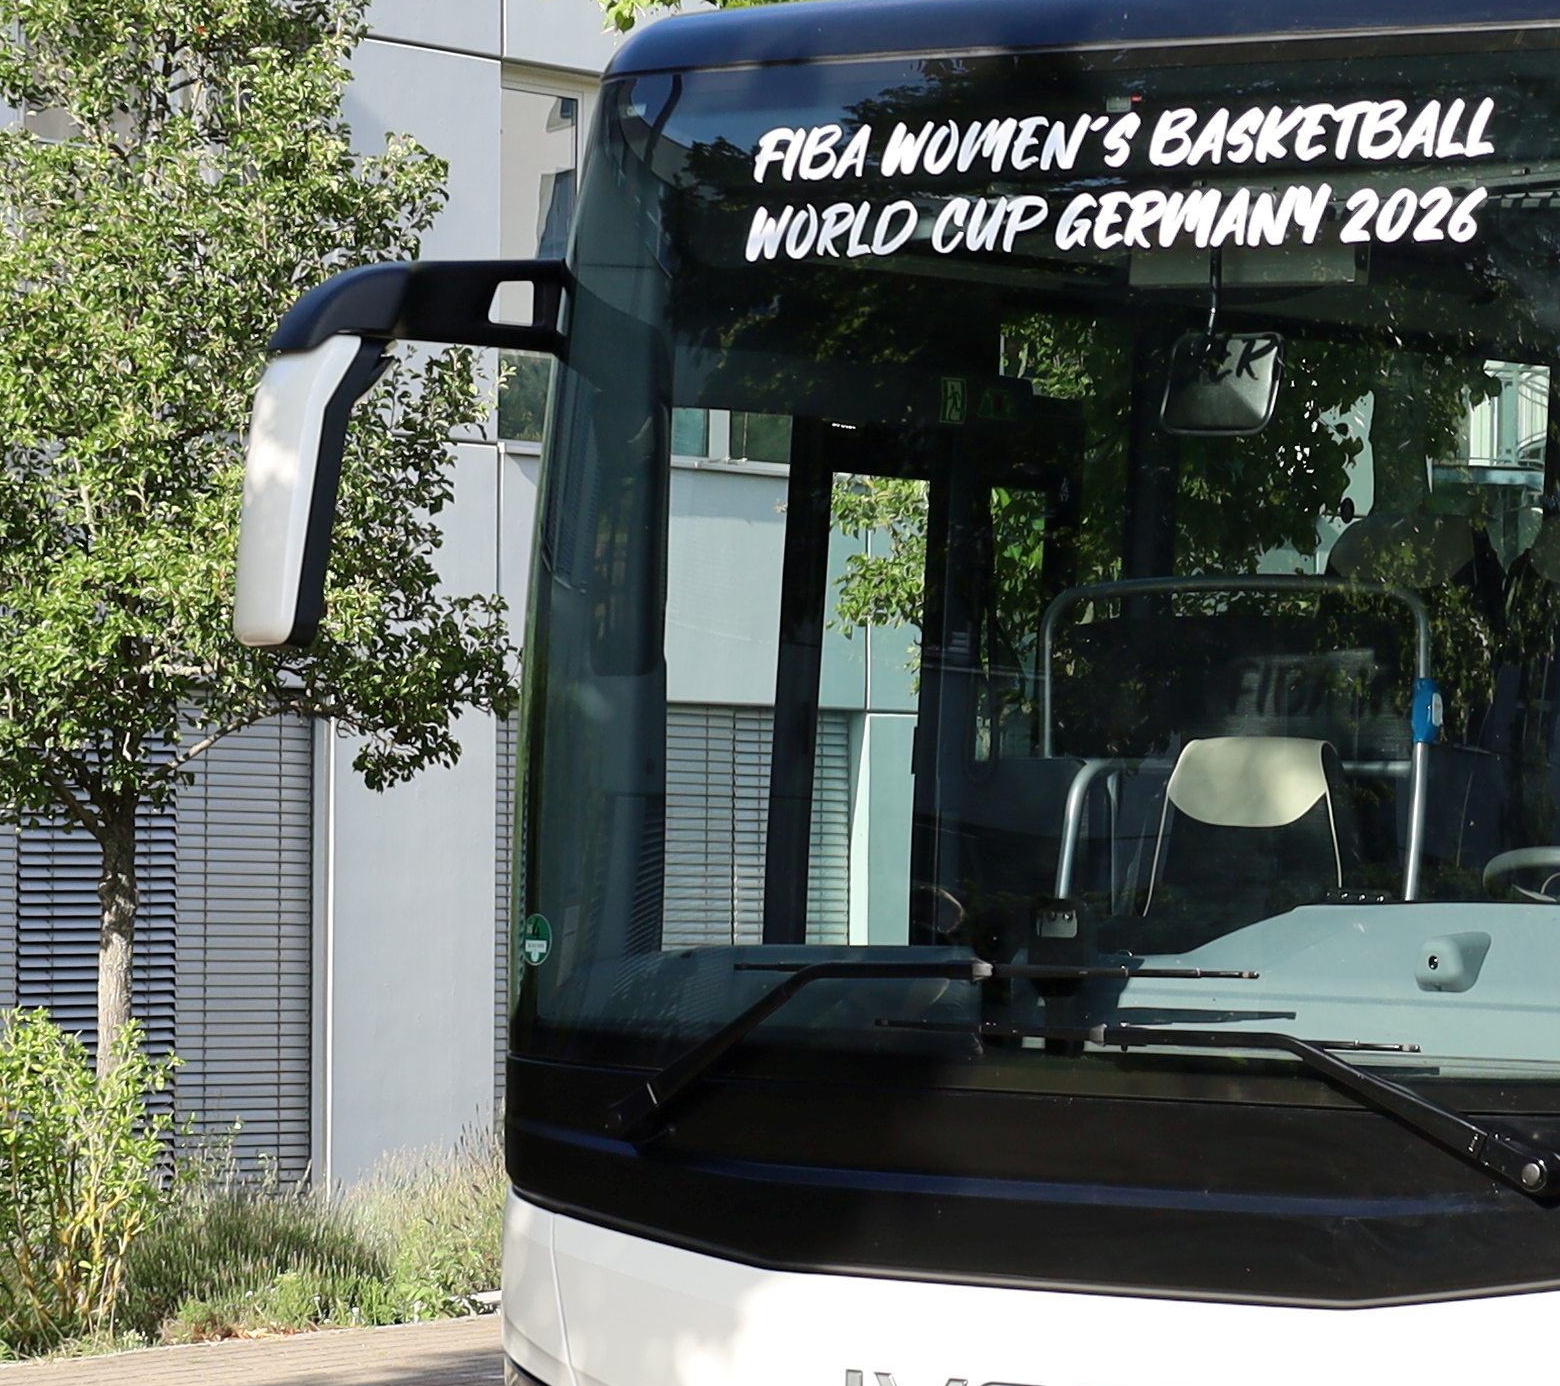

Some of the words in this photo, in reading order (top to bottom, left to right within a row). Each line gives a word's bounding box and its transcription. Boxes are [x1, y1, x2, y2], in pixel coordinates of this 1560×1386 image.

[753, 124, 866, 183] FIBA
[881, 112, 1141, 177] WOMEN'S
[1148, 97, 1496, 167] BASKETBALL
[745, 200, 919, 263] WORLD
[931, 193, 1048, 254] CUP
[1055, 182, 1332, 250] GERMANY
[1338, 186, 1490, 244] 2026
